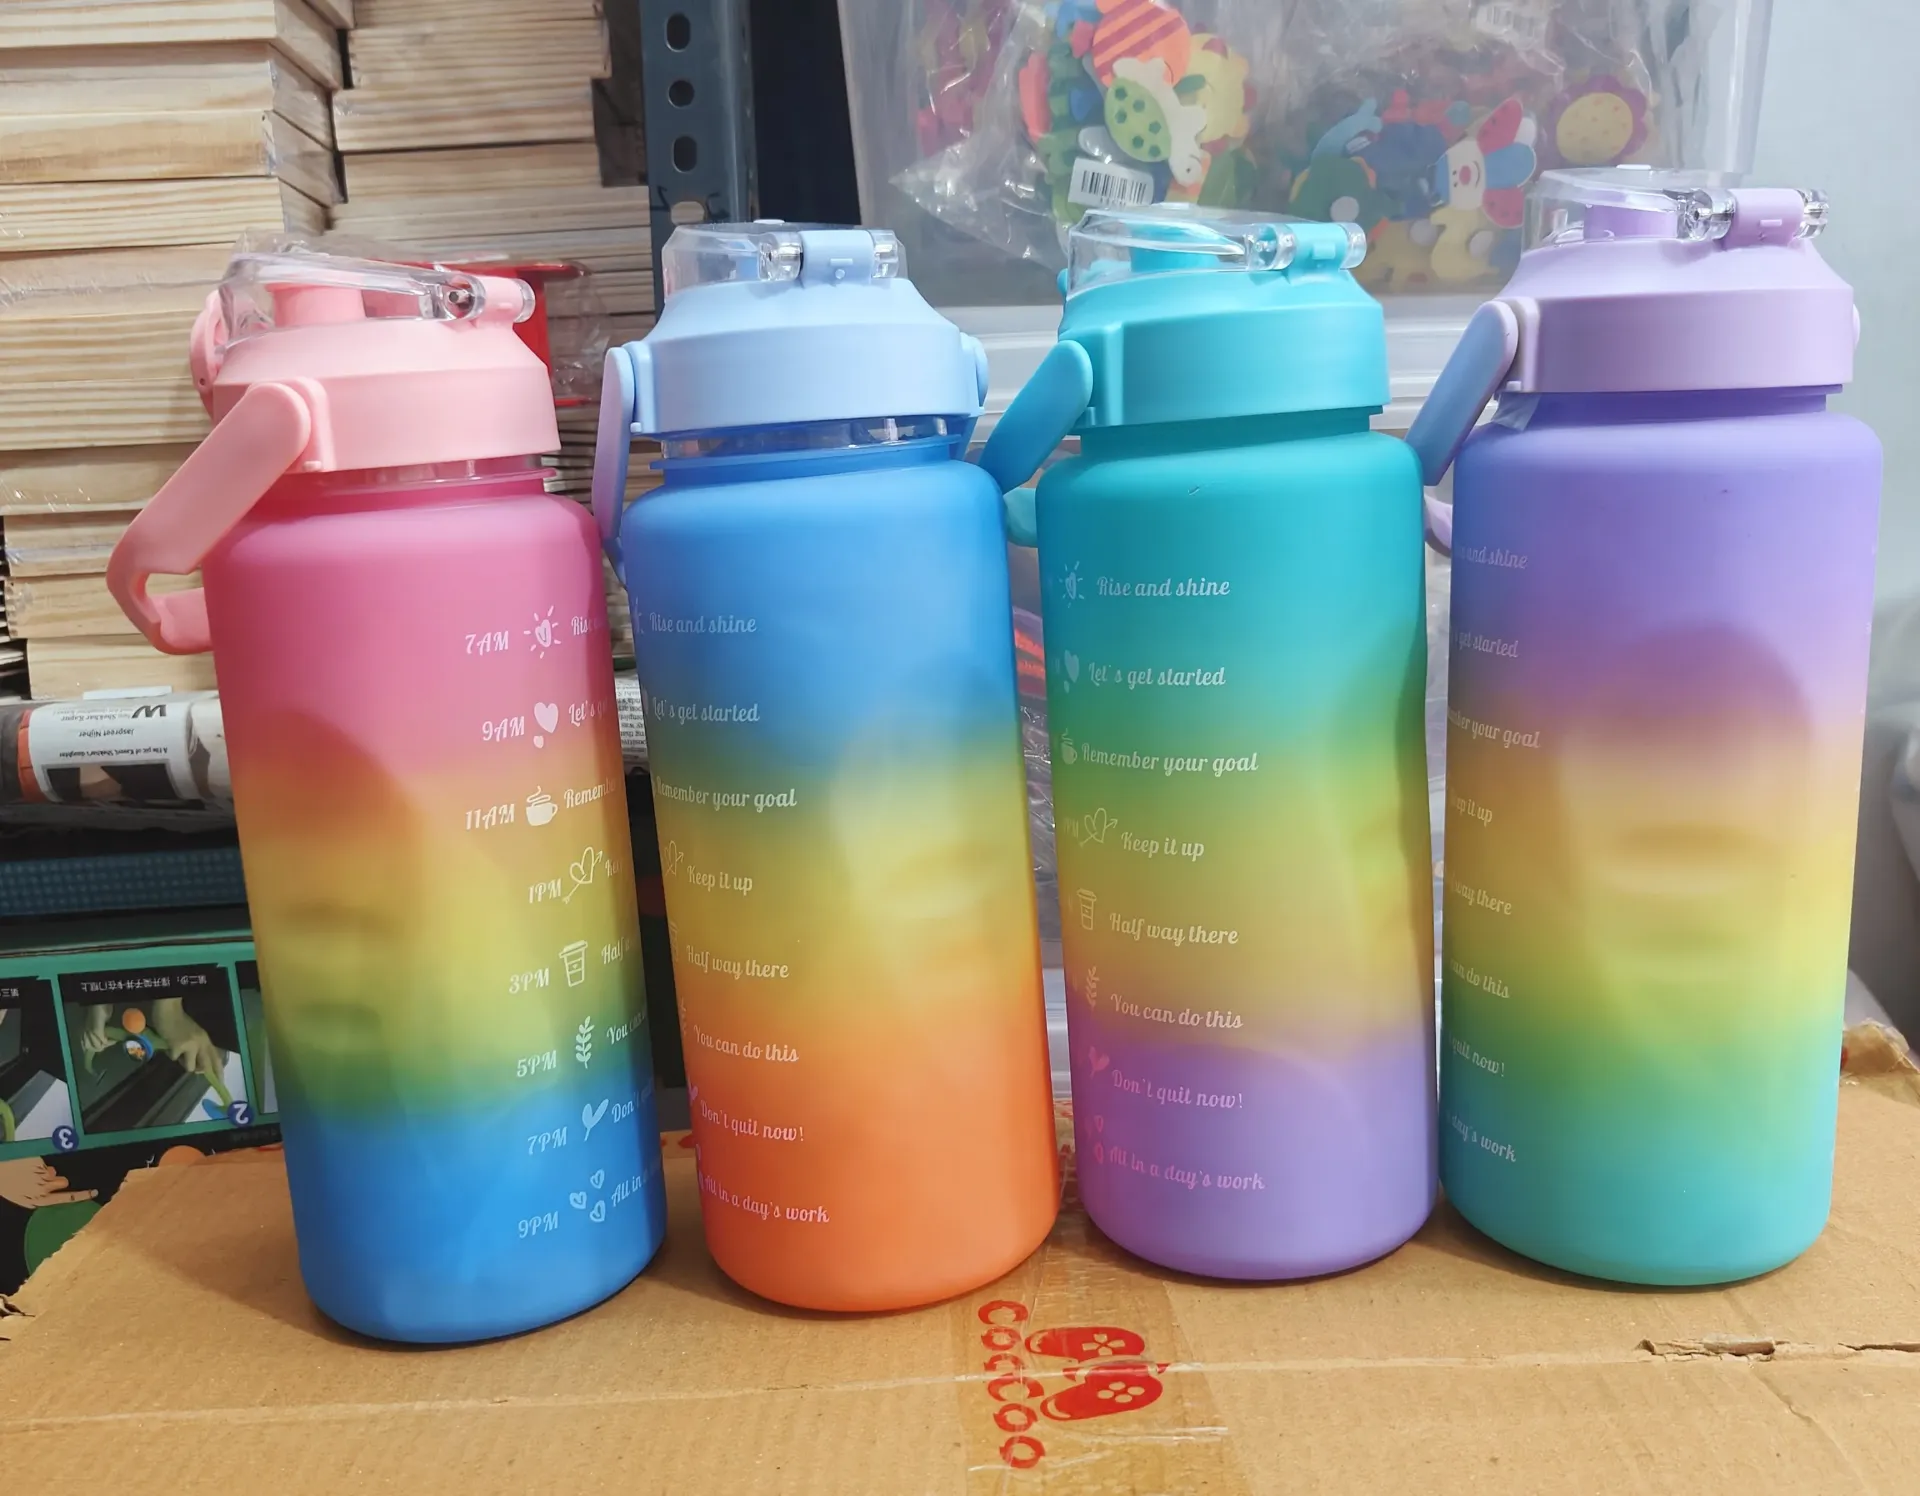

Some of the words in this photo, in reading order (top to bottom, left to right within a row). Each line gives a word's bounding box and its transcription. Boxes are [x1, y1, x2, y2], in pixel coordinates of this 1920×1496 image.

[1488, 548, 1528, 569] shine
[1097, 576, 1132, 596] Rise
[1135, 578, 1171, 596] and
[1175, 577, 1231, 596] shine
[649, 612, 673, 633] Rise
[676, 616, 705, 633] and
[708, 615, 757, 633] shine
[465, 630, 509, 655] 7AM
[1473, 634, 1519, 658] started
[1089, 662, 1123, 687] Let's
[1127, 668, 1153, 690] get
[1157, 667, 1226, 686] started
[653, 697, 675, 721] Let's
[678, 704, 698, 725] get
[701, 704, 760, 722] started
[482, 715, 525, 742] 9AM
[1472, 722, 1500, 740] your
[1503, 731, 1540, 749] goal
[1082, 742, 1159, 770] Remember
[1163, 756, 1208, 776] your
[1212, 752, 1259, 777] goal
[656, 776, 709, 805] Remember
[713, 792, 750, 811] your
[754, 788, 797, 813] goal
[465, 803, 515, 830] 11AM
[1477, 806, 1493, 828] up
[1121, 831, 1159, 858] Keep
[1164, 836, 1177, 856] it
[1181, 841, 1205, 862] up
[529, 878, 562, 904] 1PM
[687, 865, 716, 892] Keep
[719, 871, 731, 889] it
[733, 876, 753, 896] up
[1477, 889, 1512, 915] there
[1109, 912, 1145, 941] Half
[1147, 923, 1186, 947] way
[1189, 925, 1239, 944] there
[687, 945, 710, 973] Half
[712, 958, 743, 980] way
[746, 959, 790, 978] there
[508, 968, 550, 994] 3PM
[1466, 967, 1480, 986] do
[1482, 975, 1510, 999] this
[1111, 993, 1140, 1017] You
[1143, 1006, 1175, 1024] can
[1178, 1008, 1204, 1028] do
[1205, 1010, 1244, 1028] this
[516, 1050, 557, 1078] 5PM
[606, 1023, 628, 1045] You
[693, 1024, 714, 1049] You
[716, 1039, 740, 1056] can
[743, 1041, 763, 1059] do
[765, 1044, 799, 1062] this
[1472, 1052, 1505, 1078] now!
[1112, 1069, 1153, 1098] Don't
[1157, 1086, 1192, 1105] quit
[1196, 1093, 1243, 1109] now!
[233, 1103, 250, 1124] 2
[701, 1100, 729, 1129] Don't
[731, 1118, 760, 1137] quit
[763, 1125, 804, 1142] now!
[58, 1128, 74, 1150] 3
[526, 1126, 567, 1156] 7PM
[1480, 1135, 1517, 1163] work
[1109, 1146, 1127, 1168] All
[1131, 1153, 1146, 1174] in
[1150, 1162, 1160, 1178] a
[1164, 1165, 1212, 1190] day's
[1217, 1173, 1265, 1190] work
[518, 1211, 559, 1239] 9PM
[611, 1179, 630, 1207] All
[632, 1175, 642, 1192] in
[719, 1183, 729, 1203] in
[732, 1194, 740, 1208] a
[743, 1195, 781, 1221] day's
[786, 1206, 830, 1223] work
